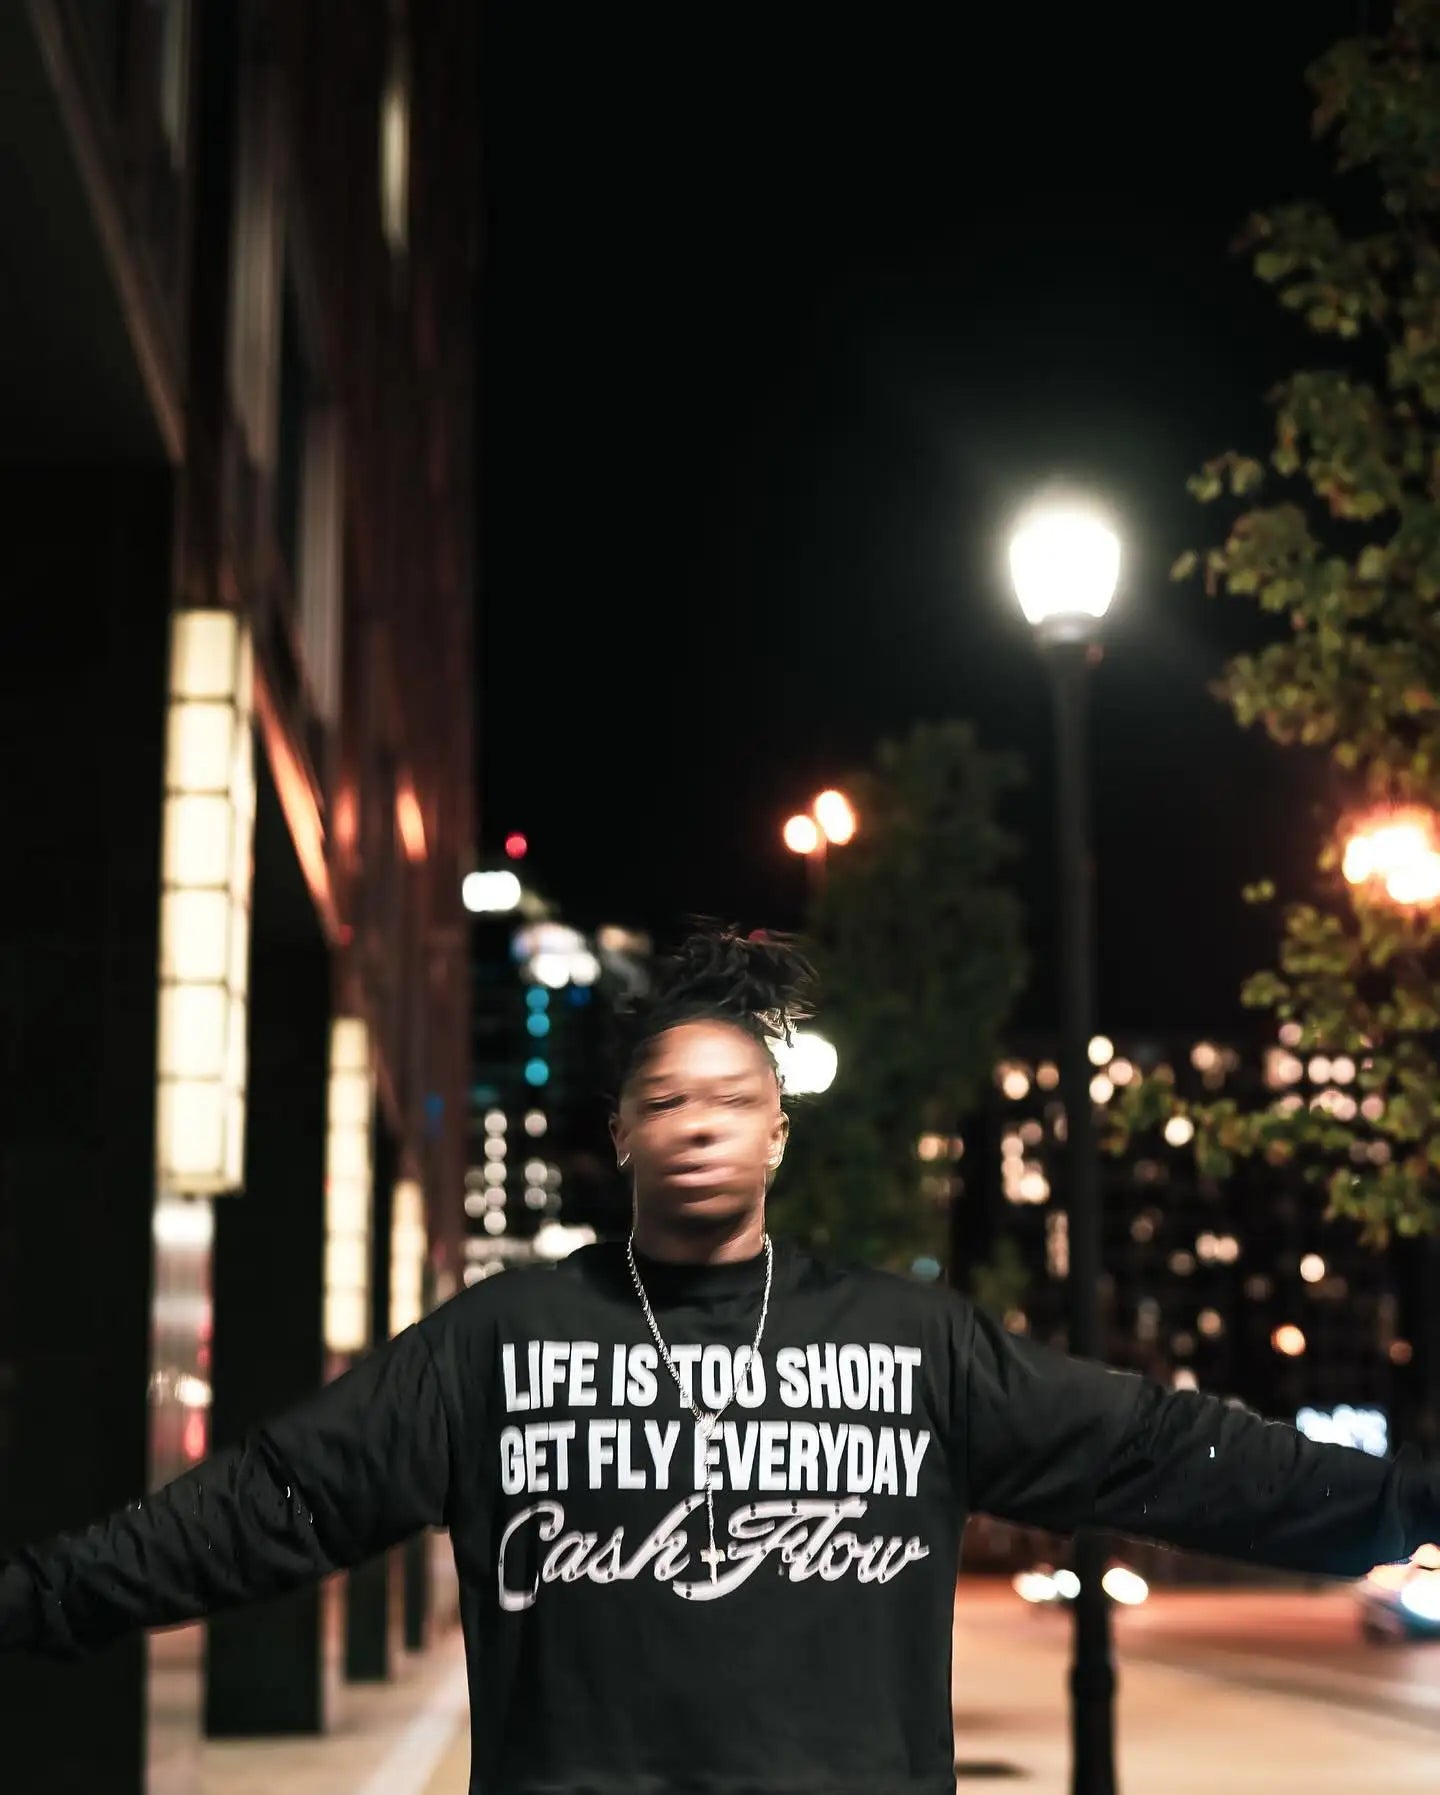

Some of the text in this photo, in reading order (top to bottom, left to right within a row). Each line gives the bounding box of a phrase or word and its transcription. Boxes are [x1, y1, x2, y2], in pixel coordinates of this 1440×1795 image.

[502, 1340, 922, 1415] LIFE IS TOO SHORT
[500, 1418, 931, 1497] GET FLY EVERYDAY
[498, 1493, 930, 1612] Cash Flow
